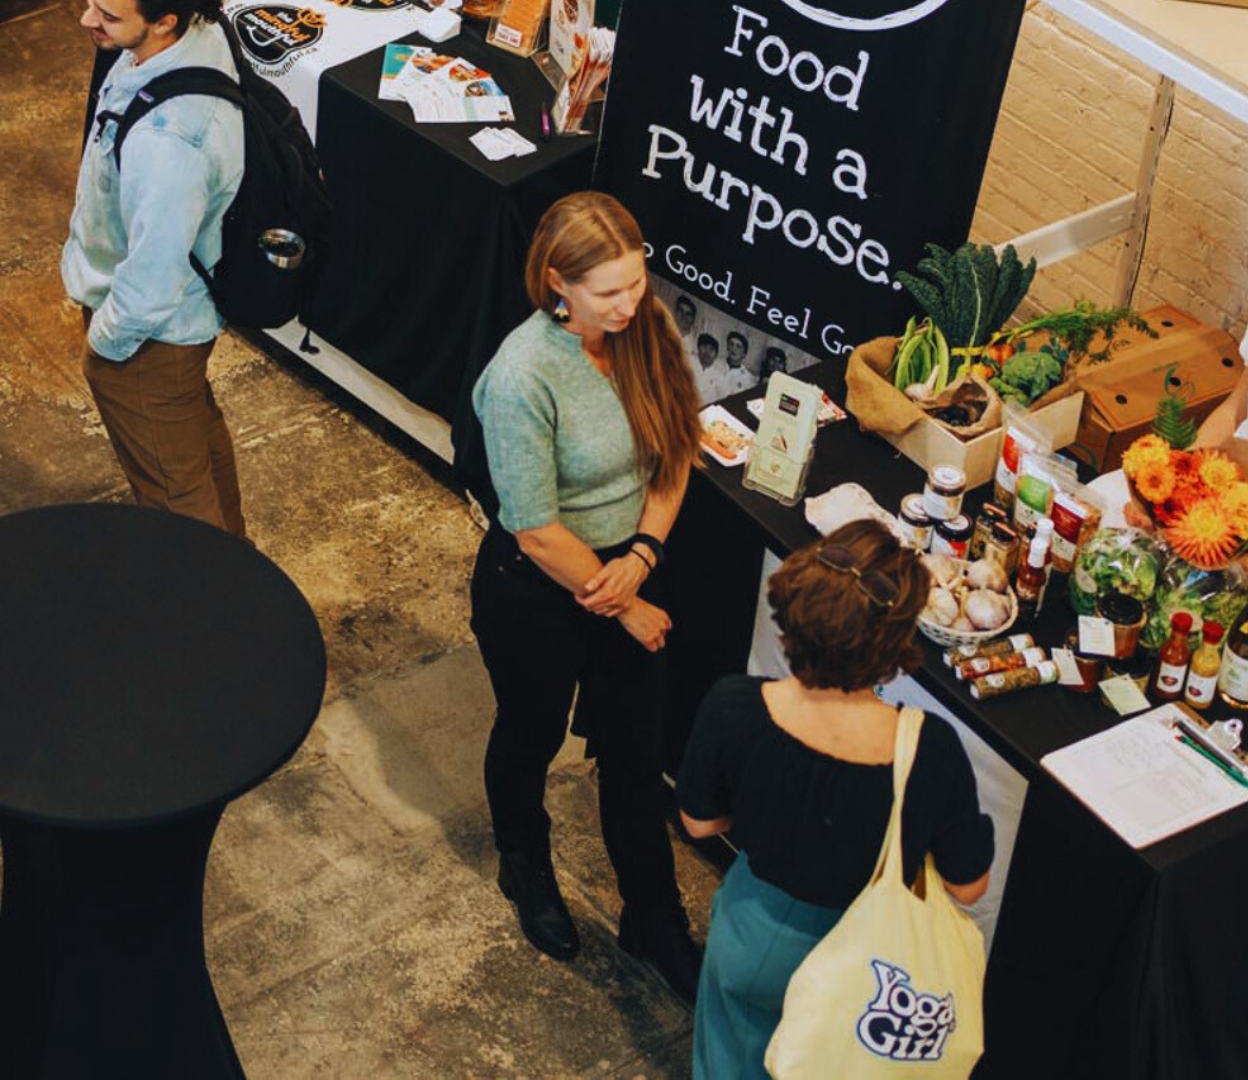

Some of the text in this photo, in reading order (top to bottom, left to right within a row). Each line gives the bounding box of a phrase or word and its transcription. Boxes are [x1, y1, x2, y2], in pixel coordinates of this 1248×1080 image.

[724, 4, 870, 111] Food
[641, 124, 904, 291] Purpose.
[833, 146, 868, 200] a
[665, 244, 736, 305] Good.
[746, 284, 811, 339] Feel
[857, 1008, 955, 1061] Girl
[870, 959, 956, 1037] Yoga
